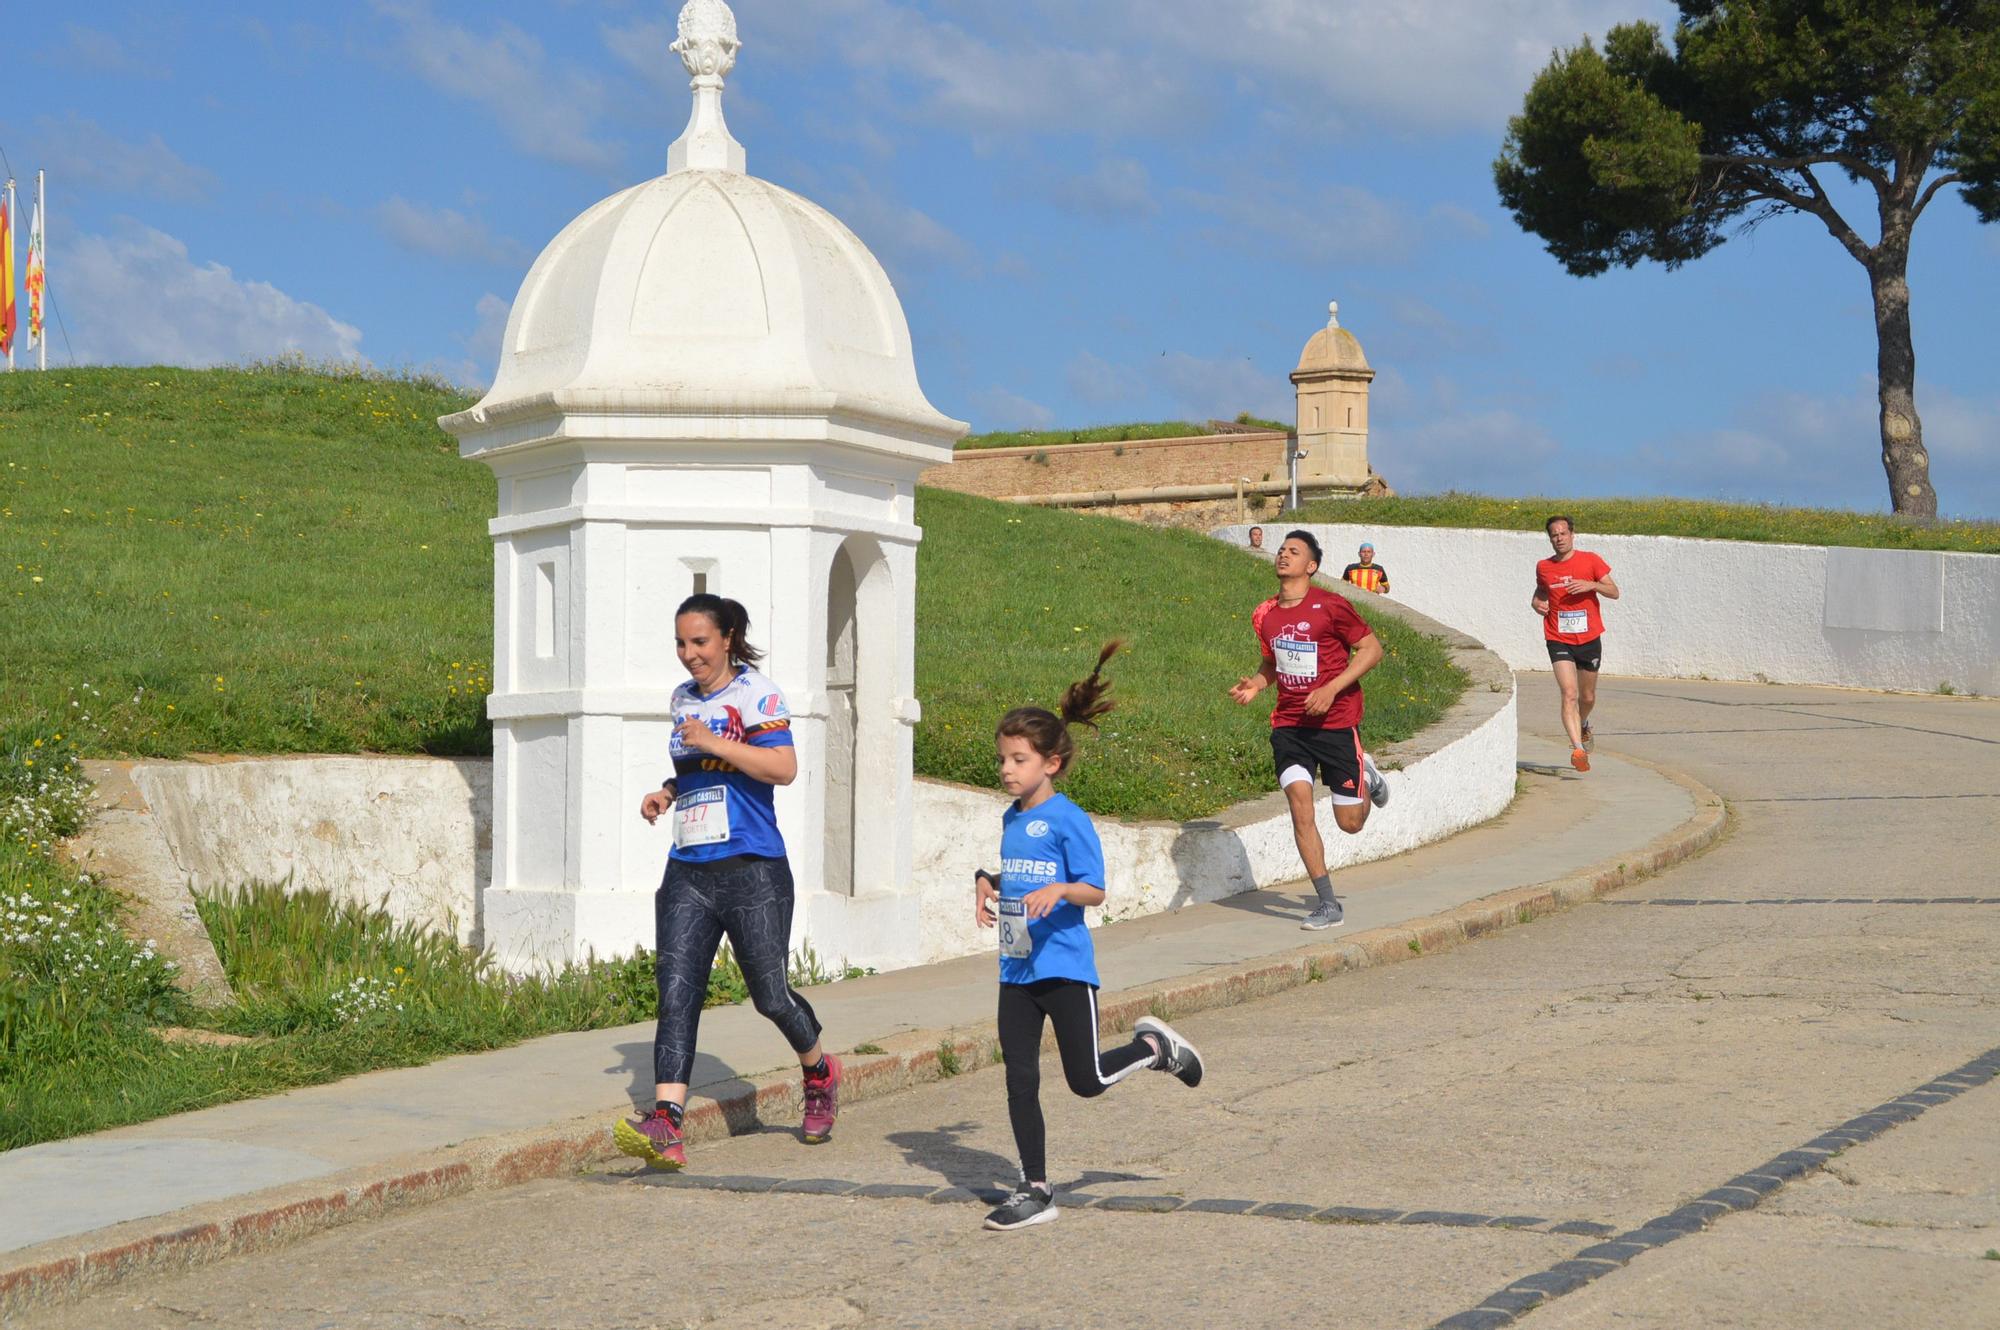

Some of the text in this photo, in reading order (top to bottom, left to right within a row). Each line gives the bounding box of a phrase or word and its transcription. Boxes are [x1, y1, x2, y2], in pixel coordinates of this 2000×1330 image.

[1564, 618, 1580, 626] 207
[1287, 650, 1301, 662] 94
[697, 789, 722, 802] CASTELL
